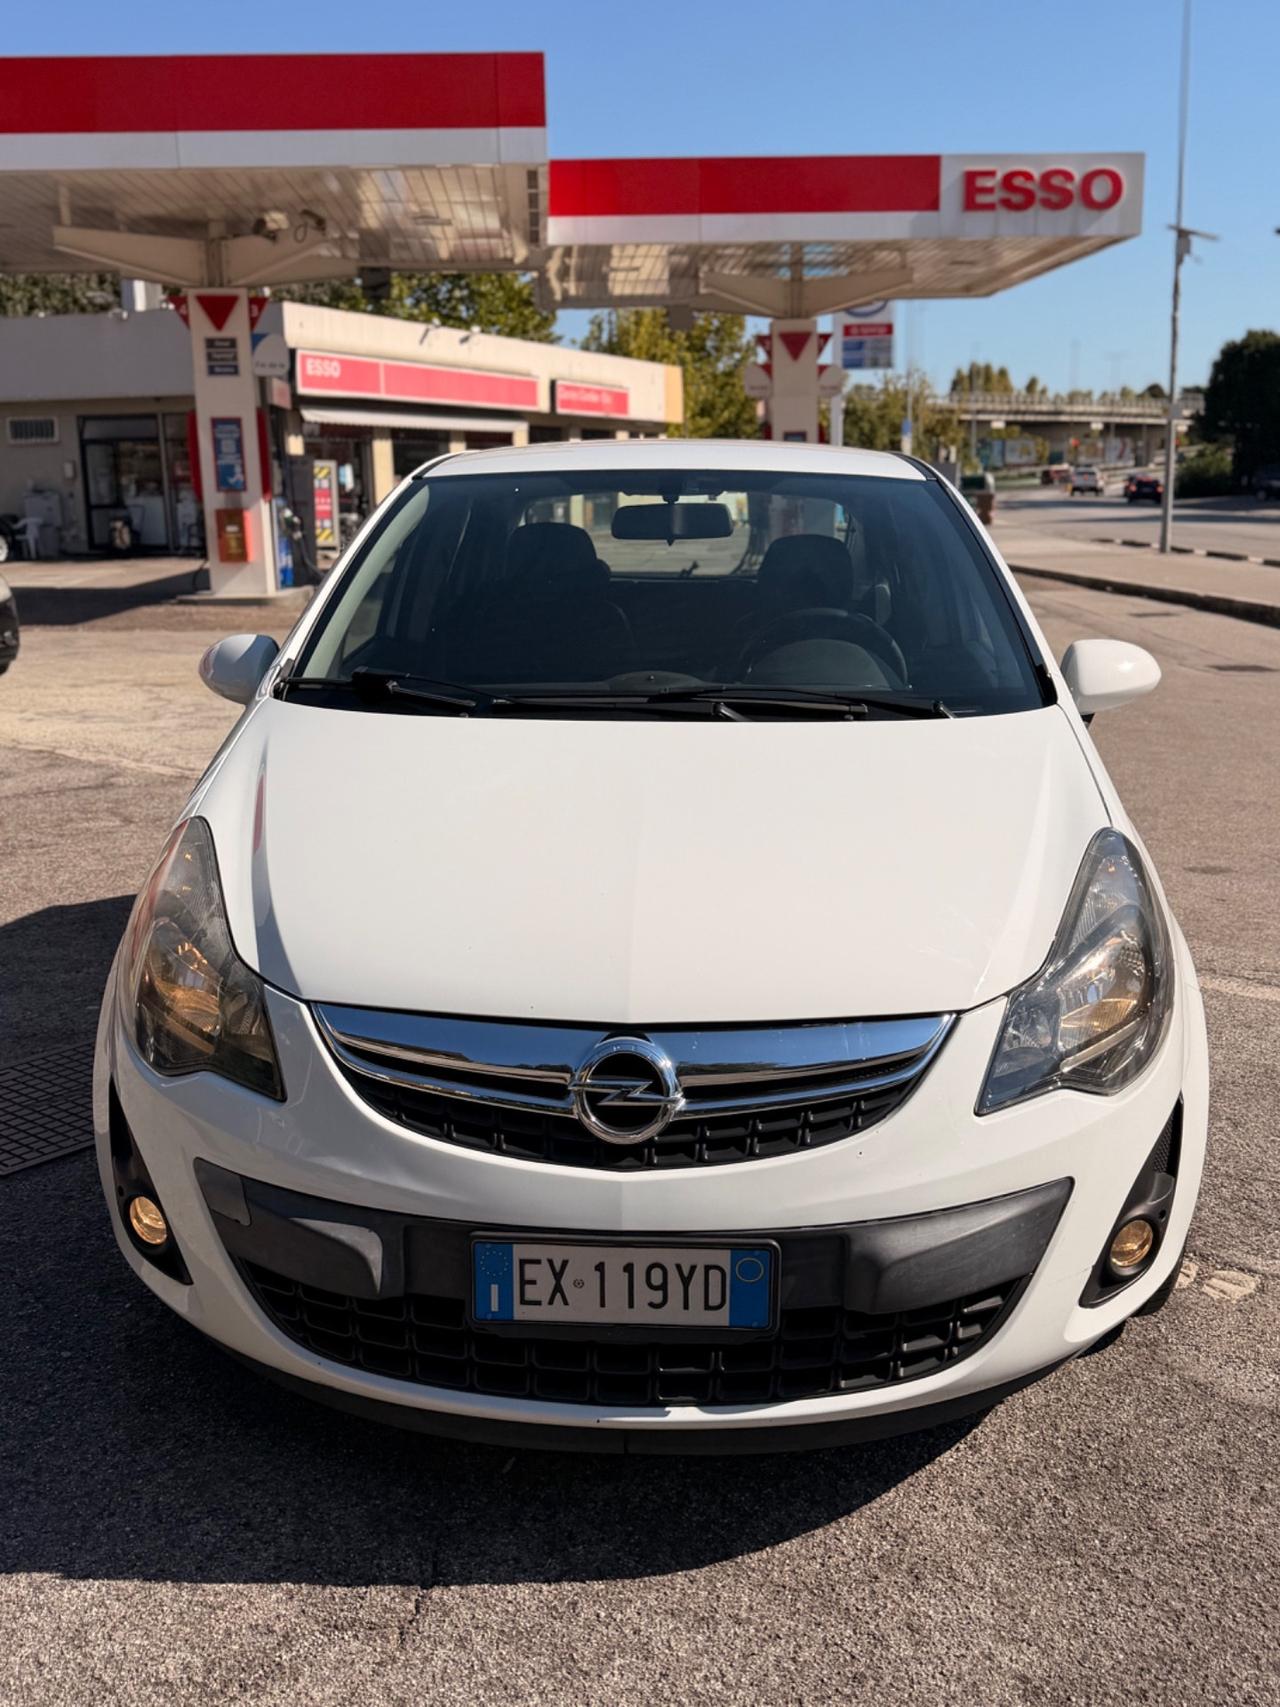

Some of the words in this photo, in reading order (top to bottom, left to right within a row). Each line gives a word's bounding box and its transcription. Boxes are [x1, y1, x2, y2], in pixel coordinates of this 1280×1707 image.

[963, 168, 1123, 212] ESSO
[306, 358, 341, 379] ESSO
[518, 1257, 570, 1307] EX
[594, 1260, 728, 1312] 119YD
